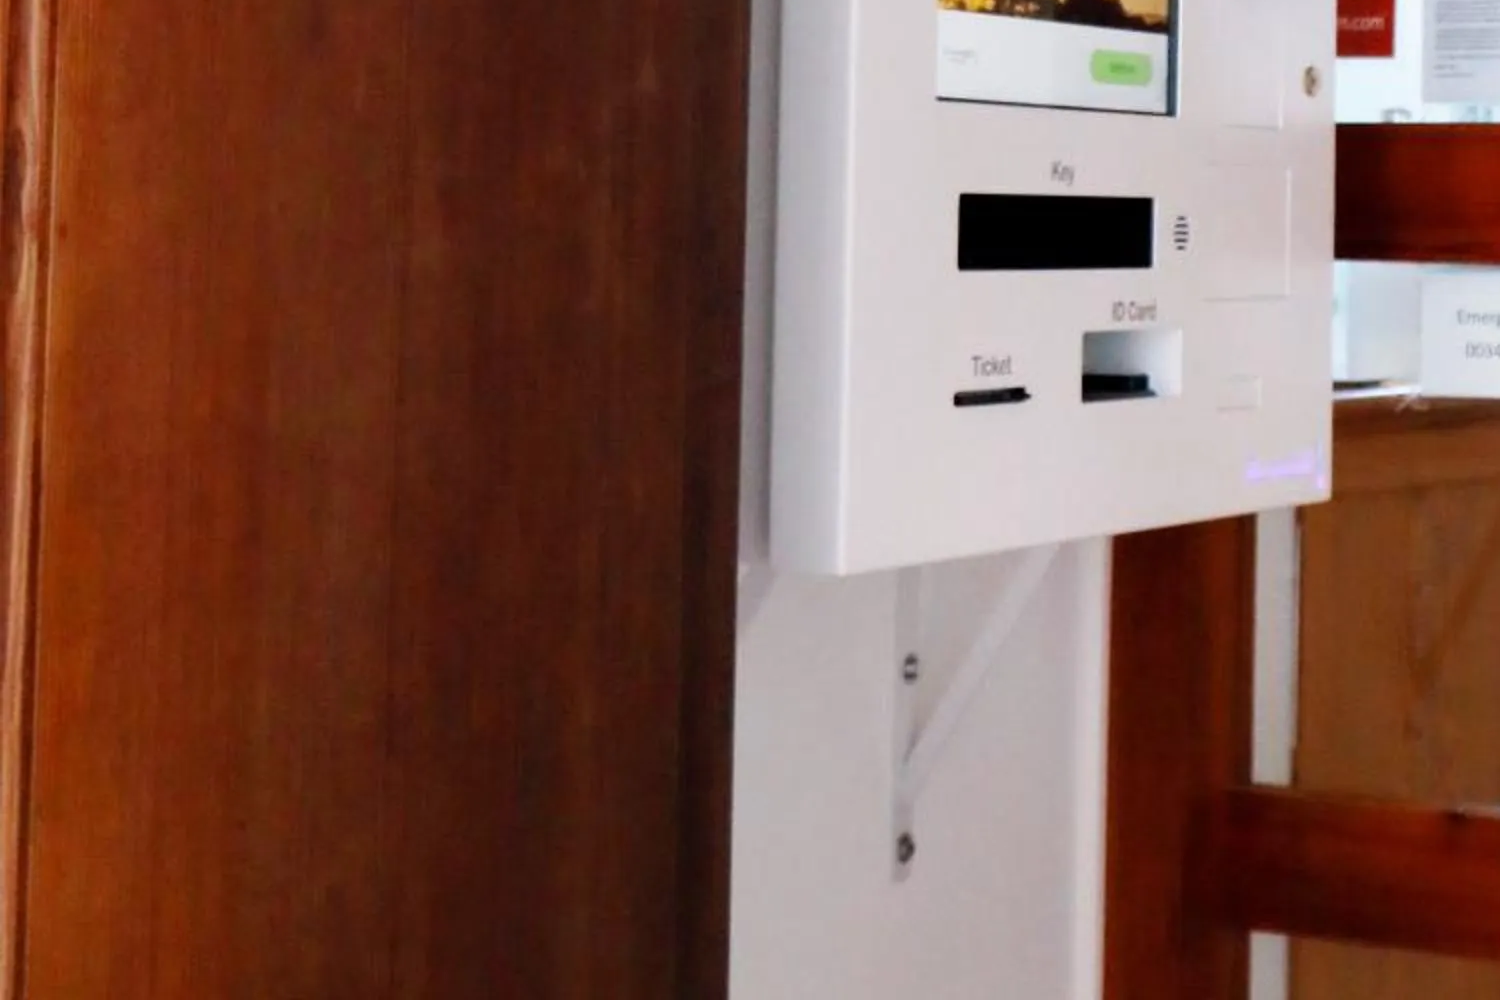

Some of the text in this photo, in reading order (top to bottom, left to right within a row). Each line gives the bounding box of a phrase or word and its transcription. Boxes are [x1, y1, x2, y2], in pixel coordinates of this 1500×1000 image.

[1051, 160, 1075, 186] Key
[1112, 300, 1157, 322] ID Card
[972, 356, 1012, 377] Ticket
